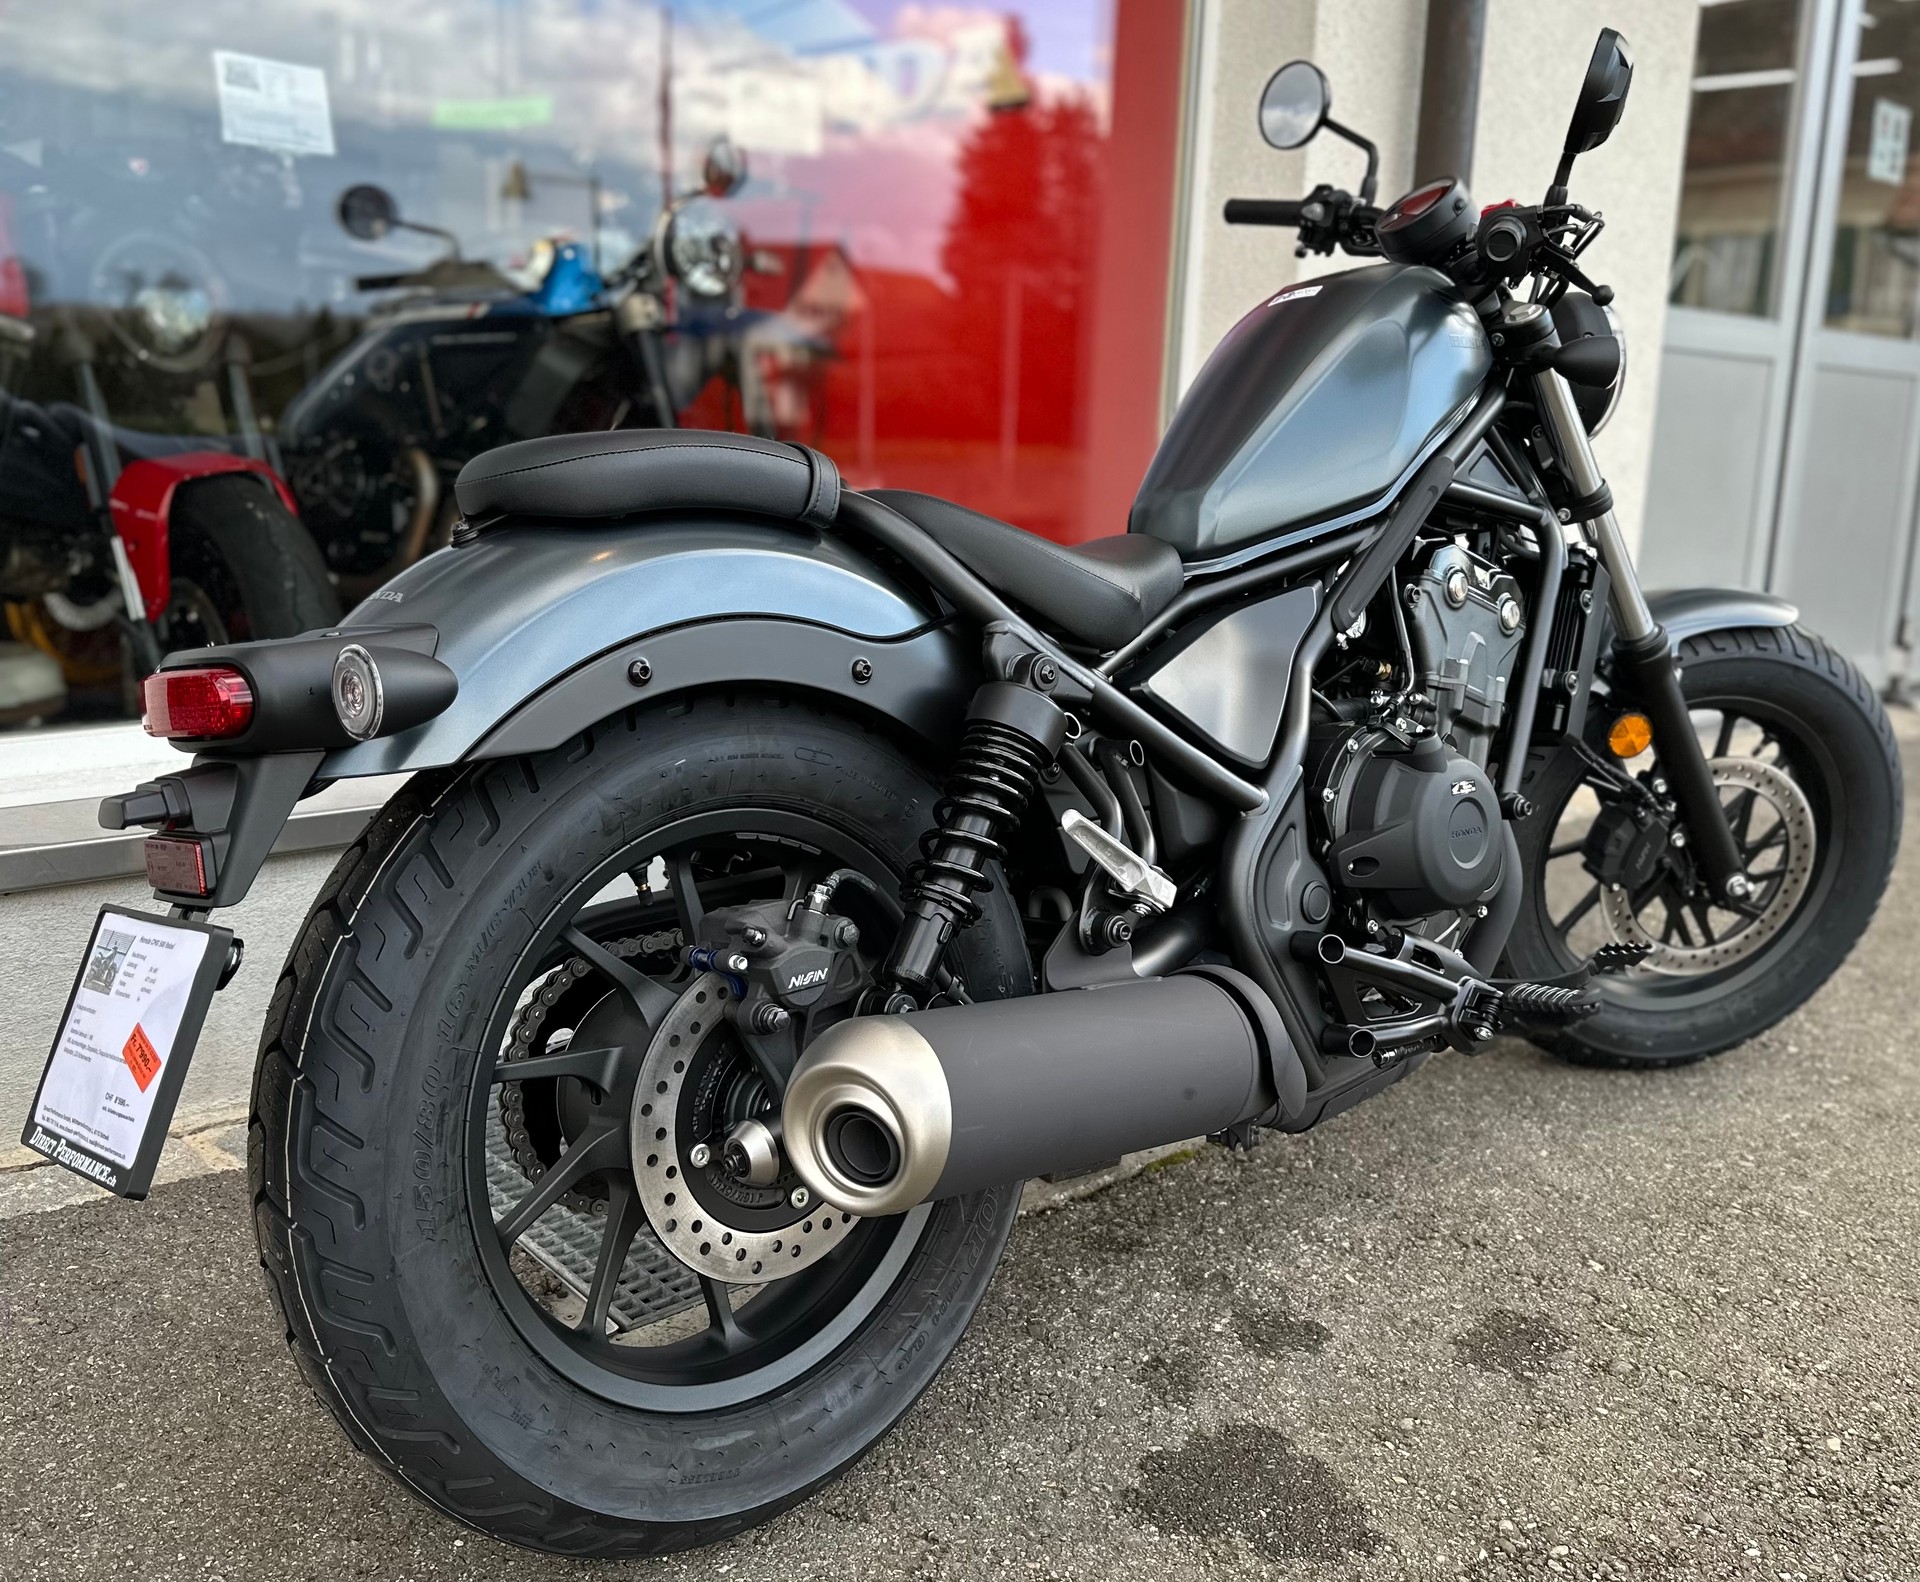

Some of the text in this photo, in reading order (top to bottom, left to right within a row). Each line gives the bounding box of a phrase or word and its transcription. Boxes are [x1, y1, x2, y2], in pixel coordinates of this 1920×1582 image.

[369, 591, 404, 602] NDA
[1451, 826, 1482, 838] HONDA
[788, 967, 829, 990] NISSIN
[29, 1126, 58, 1154] DIRECT
